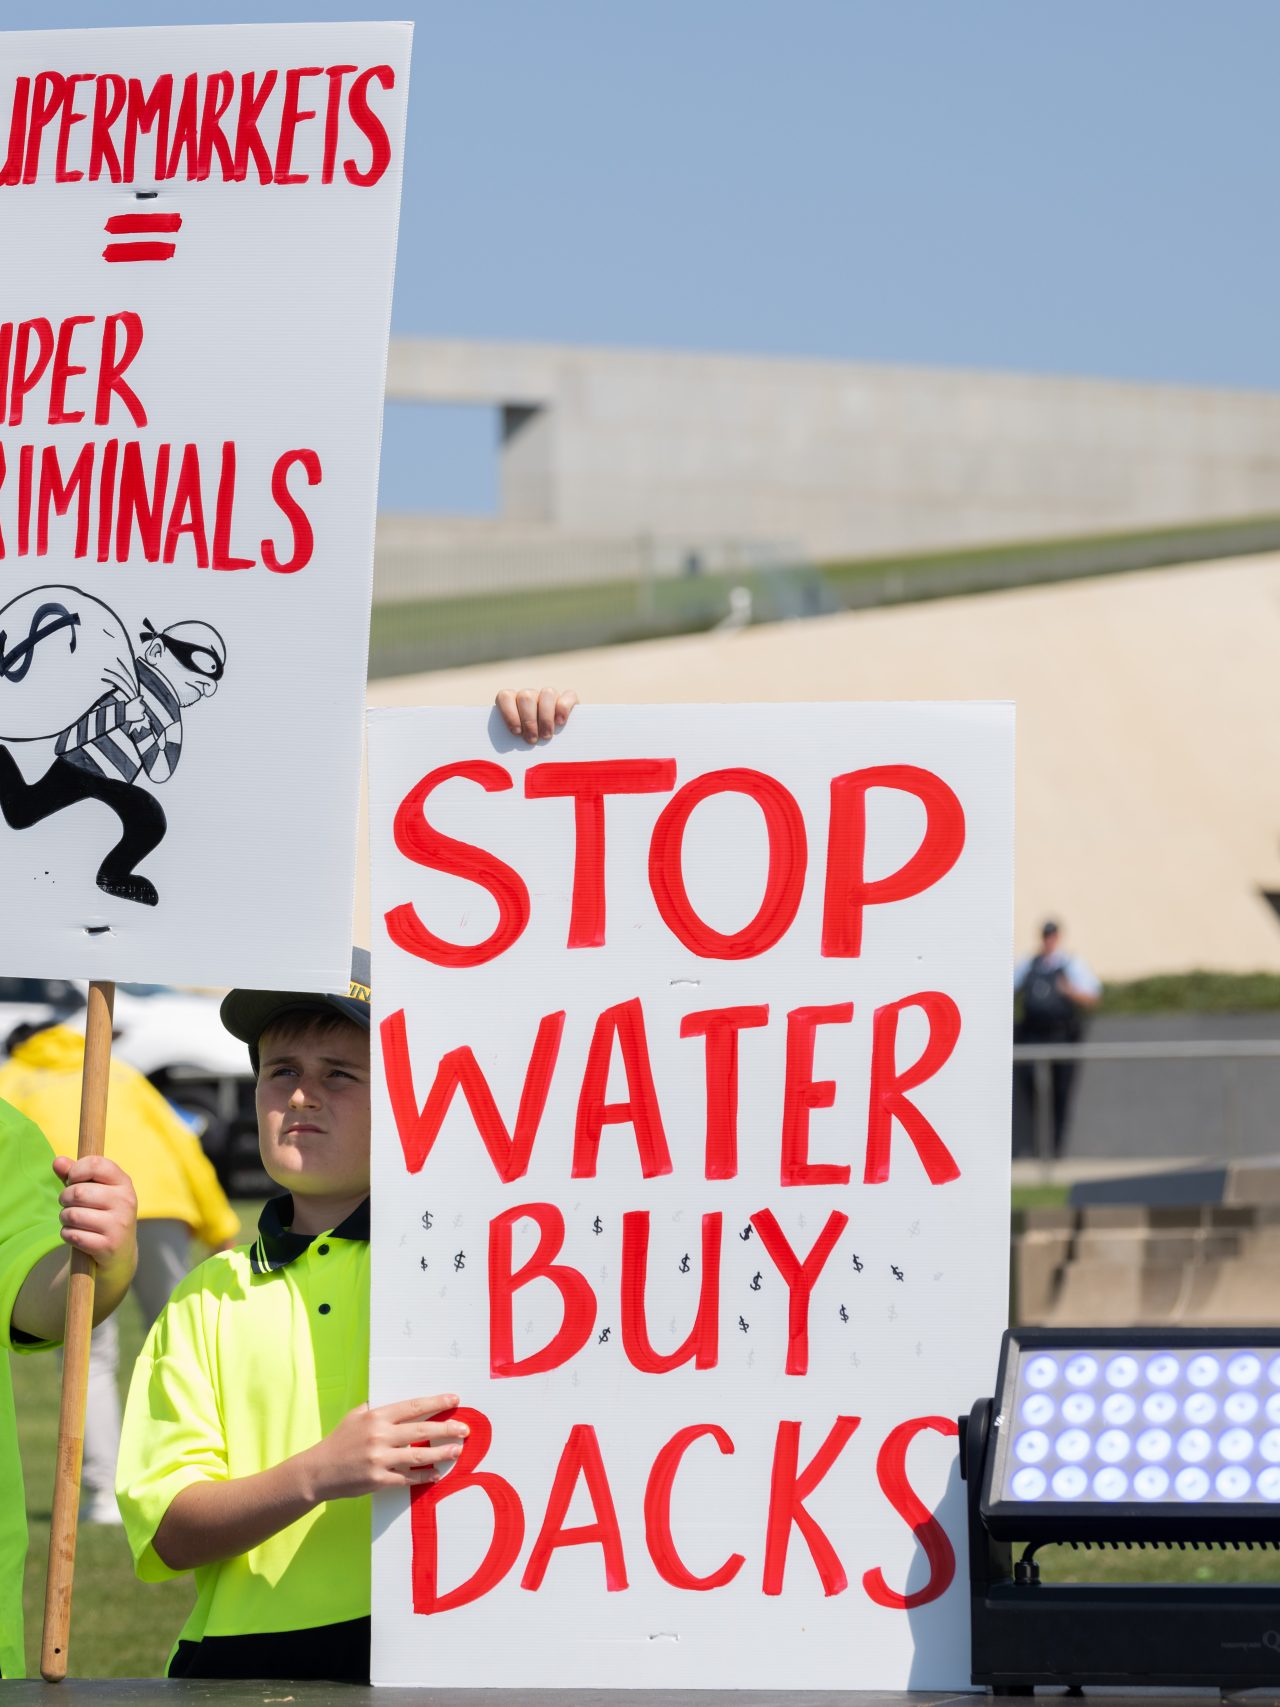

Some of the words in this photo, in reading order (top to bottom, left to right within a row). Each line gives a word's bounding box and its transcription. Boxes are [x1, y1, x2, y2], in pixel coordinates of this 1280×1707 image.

[384, 759, 965, 968] STOP
[380, 991, 961, 1187] WATER
[488, 1203, 848, 1379] BUY
[410, 1407, 959, 1615] BACKS
